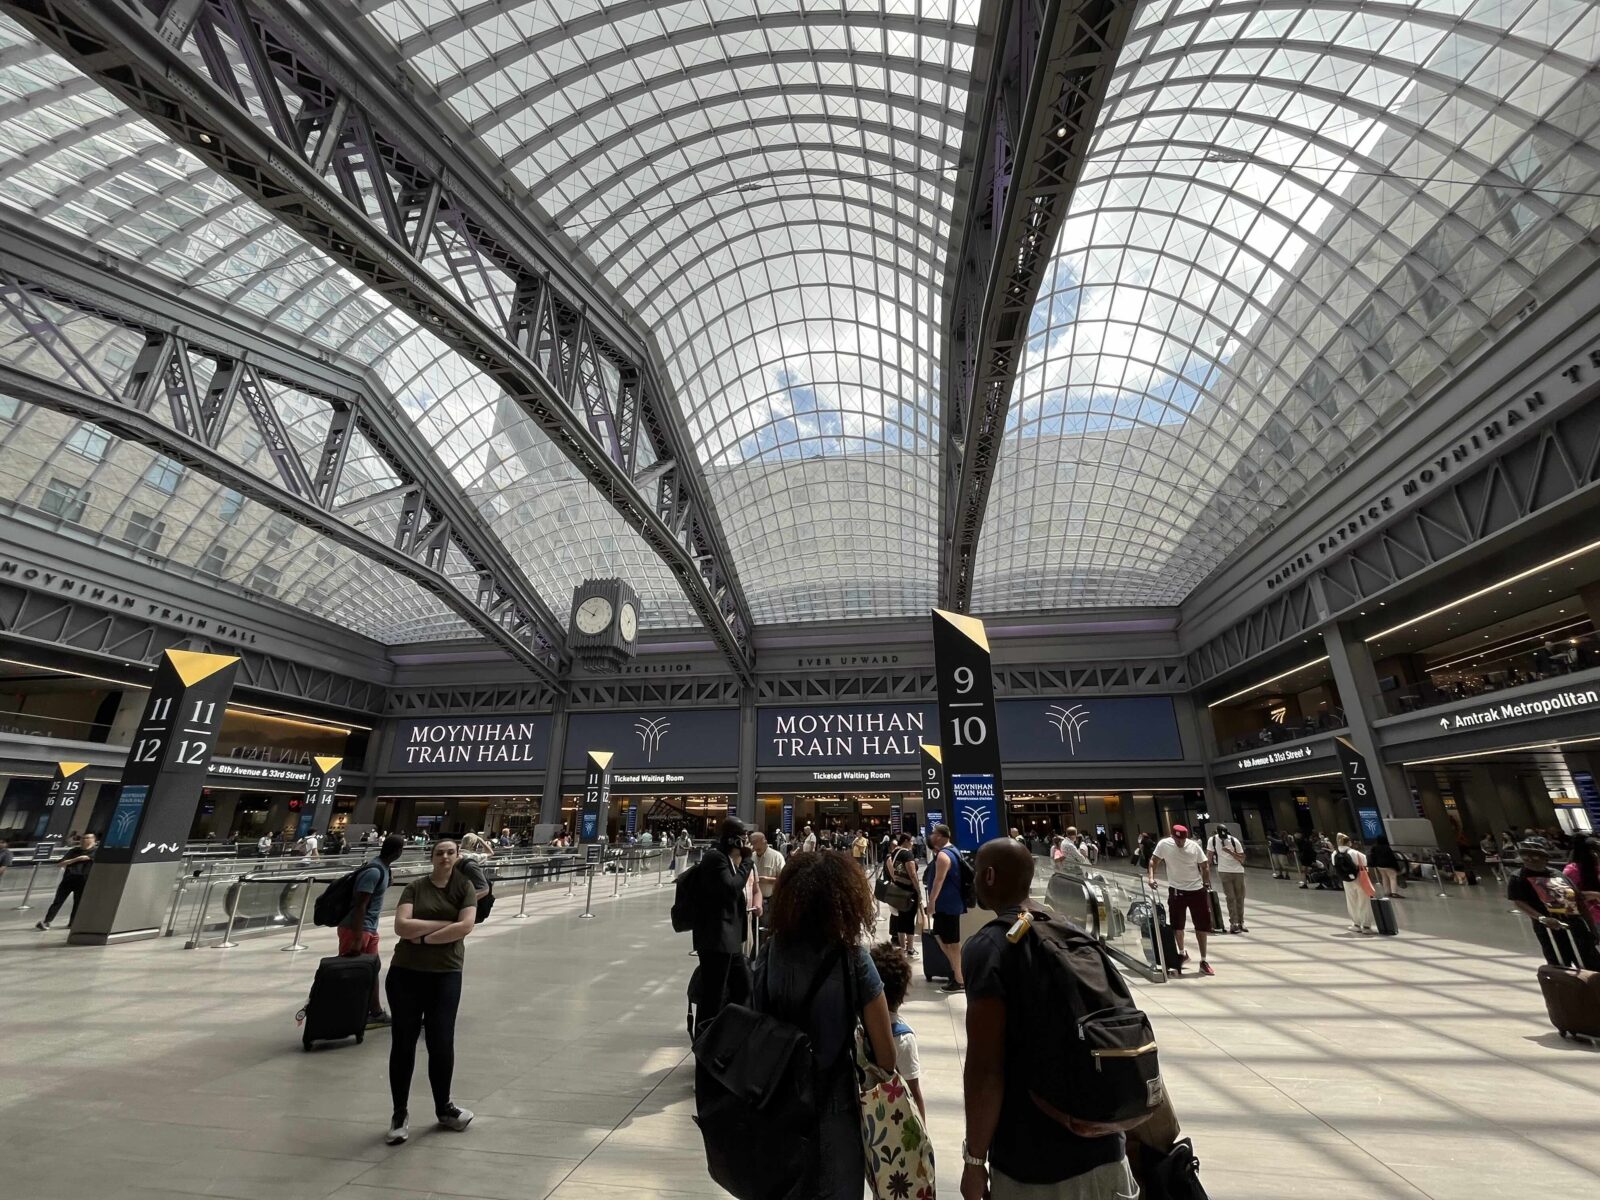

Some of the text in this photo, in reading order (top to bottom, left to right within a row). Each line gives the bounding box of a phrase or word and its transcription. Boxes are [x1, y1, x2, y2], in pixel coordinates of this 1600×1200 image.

[1267, 553, 1312, 589] DANIEL
[1318, 497, 1392, 554] PATRICK
[1403, 391, 1545, 496] MOYNIHAN
[0, 561, 256, 644] MOYNIHAN TRAIN HALL
[798, 655, 899, 667] EVER UPWARD
[953, 666, 974, 694] 9
[149, 697, 172, 721] 11
[189, 700, 216, 725] 11
[1455, 690, 1599, 728] Amtrak Metropolitan
[776, 712, 924, 734] MOYNIHAN
[410, 723, 535, 743] MOYNIHAN
[950, 716, 987, 746] 10
[133, 738, 161, 762] 12
[175, 740, 207, 765] 12
[773, 737, 852, 756] TRAIN
[406, 744, 534, 763] TRAIN HALL
[1286, 749, 1304, 760] Street
[219, 765, 232, 773] 8th
[233, 767, 261, 776] Avenue
[269, 769, 285, 778] 33rd
[285, 771, 307, 780] Street
[927, 768, 936, 780] 9
[1349, 762, 1359, 774] 7
[309, 777, 320, 787] 13
[325, 777, 336, 787] 13
[589, 774, 599, 784] 11
[604, 774, 610, 785] 11
[641, 774, 664, 782] Waiting
[813, 772, 842, 780] Ticketed
[843, 772, 869, 780] Waiting
[51, 781, 61, 790] 15
[66, 781, 80, 790] 15
[1356, 783, 1367, 795] 8
[305, 793, 316, 804] 14
[321, 794, 332, 805] 14
[586, 791, 598, 803] 12
[602, 792, 609, 803] 12
[927, 787, 940, 800] 10
[45, 797, 56, 806] 16
[60, 797, 75, 806] 16
